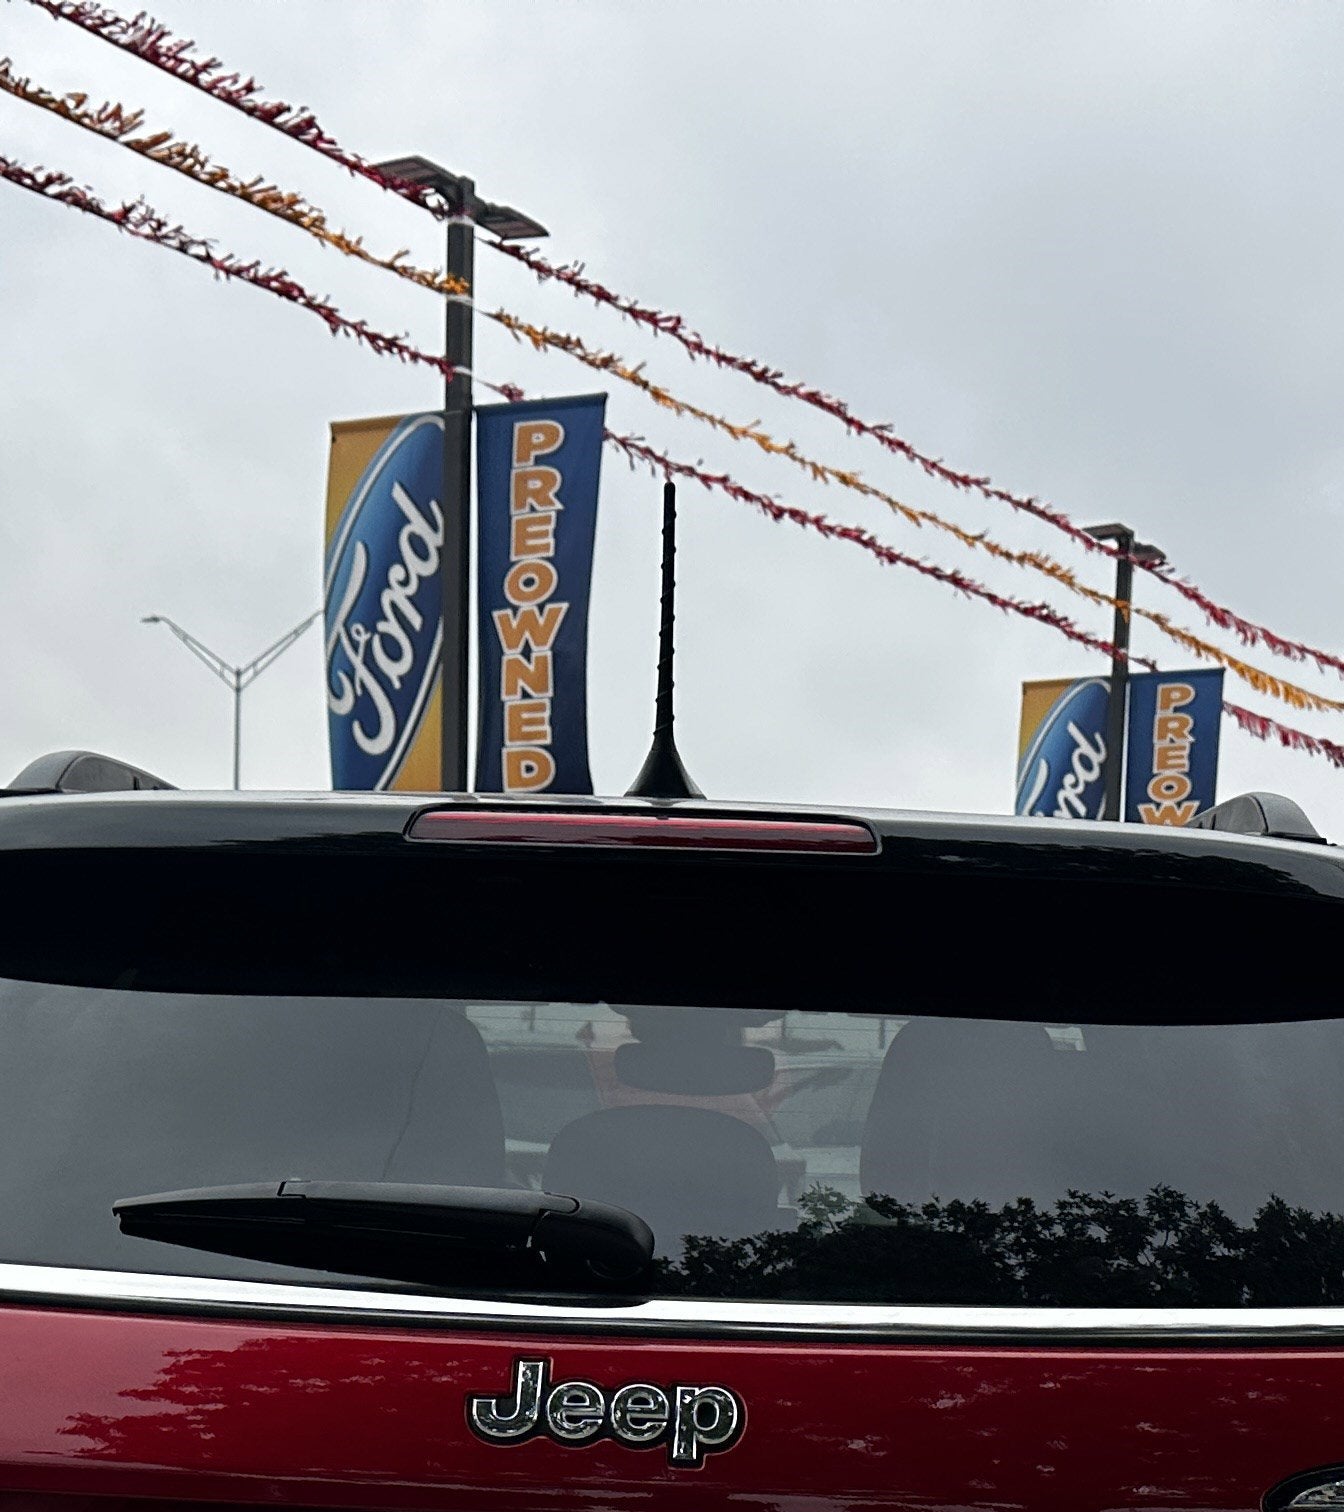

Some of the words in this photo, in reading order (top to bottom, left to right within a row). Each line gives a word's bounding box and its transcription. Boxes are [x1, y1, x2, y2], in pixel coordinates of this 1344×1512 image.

[326, 481, 445, 756] Ford
[492, 419, 570, 794] PREOWNED
[471, 1360, 739, 1460] Jeep
